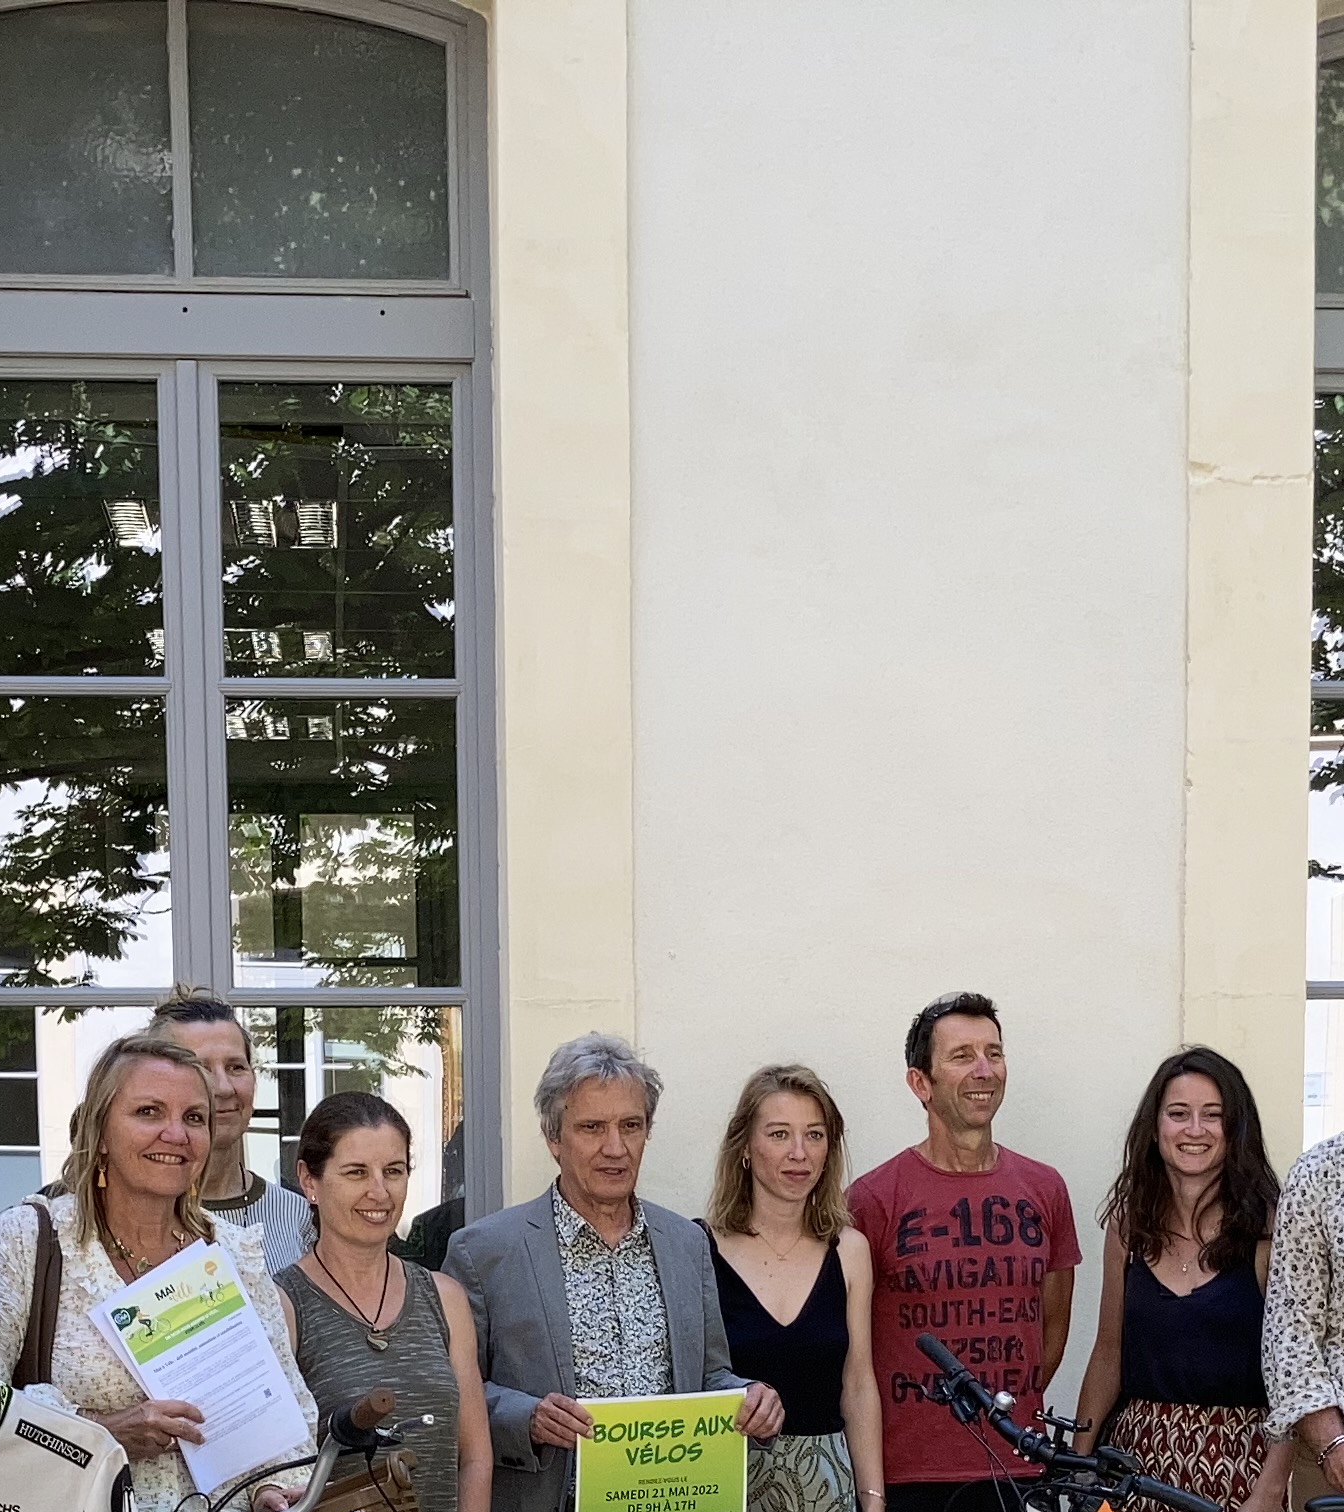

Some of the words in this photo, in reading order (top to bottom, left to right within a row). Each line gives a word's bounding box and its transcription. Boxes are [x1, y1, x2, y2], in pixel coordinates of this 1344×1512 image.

[895, 1195, 1044, 1257] E-168
[154, 1283, 176, 1302] MAI
[592, 1418, 686, 1444] BOURSE
[693, 1414, 736, 1438] AUX
[18, 1422, 89, 1465] HUTCHINSON
[625, 1441, 704, 1466] VÉLOS
[605, 1488, 650, 1502] SAMEDI
[651, 1488, 665, 1498] 21
[668, 1486, 690, 1497] MAI
[691, 1484, 719, 1496] 2022
[645, 1502, 661, 1512] 9H
[663, 1499, 672, 1512] À
[675, 1500, 696, 1511] 17H
